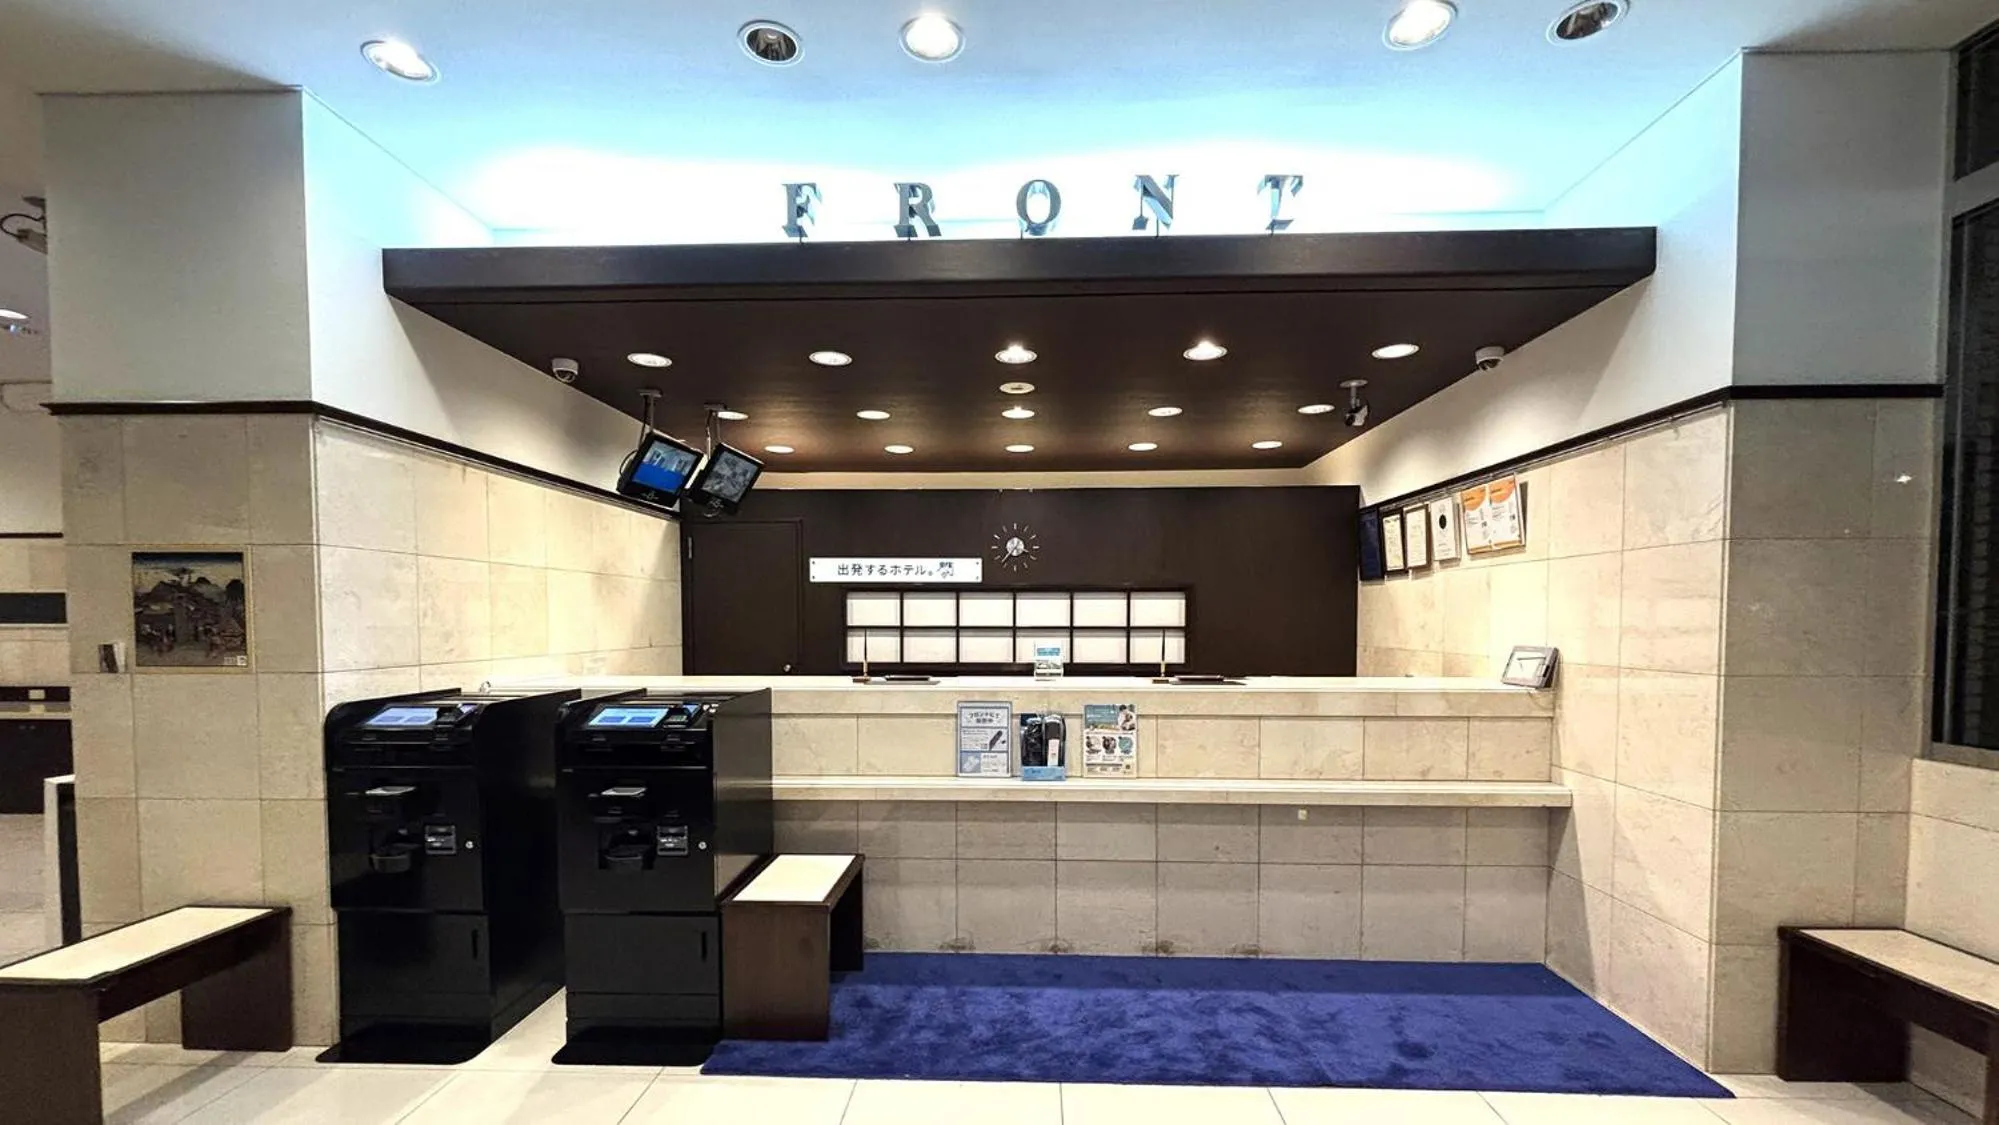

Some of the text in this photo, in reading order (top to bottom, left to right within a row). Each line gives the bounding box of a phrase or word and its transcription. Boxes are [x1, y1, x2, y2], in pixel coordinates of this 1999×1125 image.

[782, 174, 1304, 238] FRONT
[837, 563, 934, 577] 出発するホテル。
